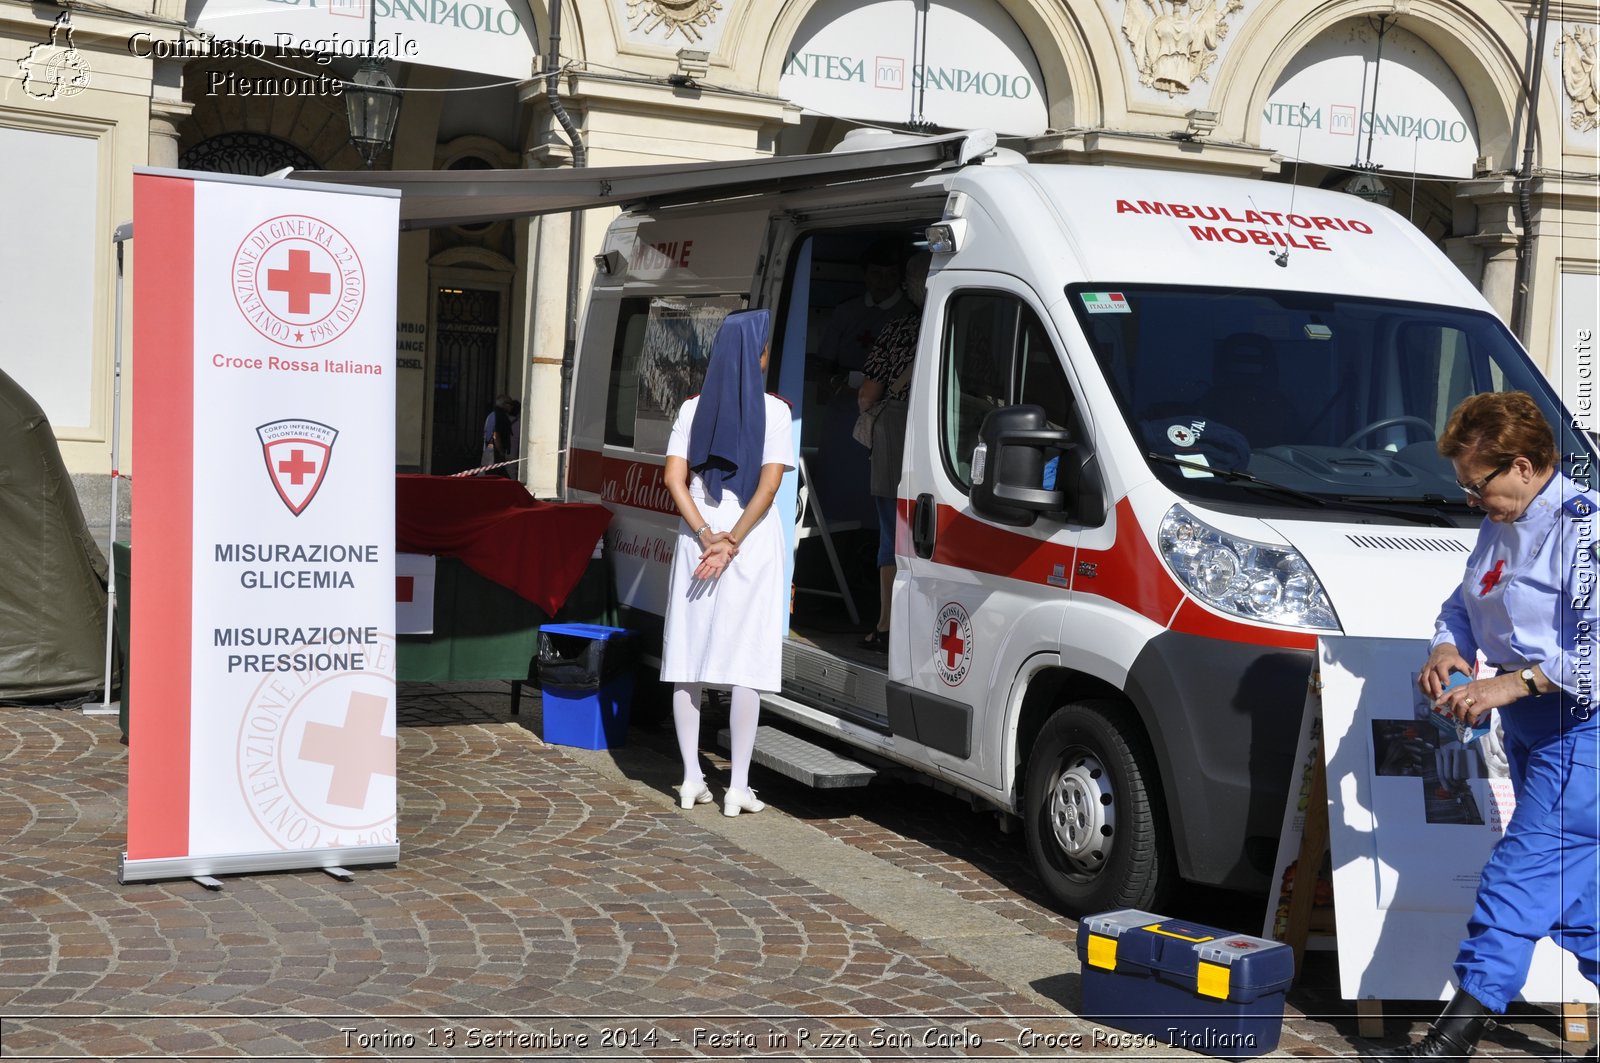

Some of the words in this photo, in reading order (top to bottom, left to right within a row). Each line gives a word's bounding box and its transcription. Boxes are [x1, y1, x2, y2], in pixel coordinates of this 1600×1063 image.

[375, 0, 521, 37] SANPAOLO
[912, 64, 1032, 100] SANPAOLO
[1361, 112, 1467, 143] SANPAOLO
[1116, 199, 1374, 235] AMBULATORIO
[251, 230, 271, 250] DI
[270, 220, 334, 248] GINEVRA
[1189, 225, 1333, 251] MOBILE
[335, 247, 353, 265] 22
[629, 241, 693, 271] MOBILE
[236, 248, 290, 341] CONVENZIONE
[336, 269, 361, 323] AGOSTO
[310, 319, 339, 342] 1864
[212, 353, 263, 369] Croce
[268, 356, 319, 372] Rossa
[324, 359, 382, 375] Italiana
[264, 424, 288, 434] CORPO
[289, 424, 331, 437] INFERMIERE
[268, 430, 309, 440] VOLONTARIE
[214, 543, 379, 563] MISURAZIONE
[640, 536, 652, 560] di
[240, 570, 355, 589] GLICEMIA
[942, 606, 960, 619] ROSSA
[213, 626, 379, 647] MISURAZIONE
[227, 652, 365, 673] PRESSIONE
[937, 659, 966, 683] CHIVASSO
